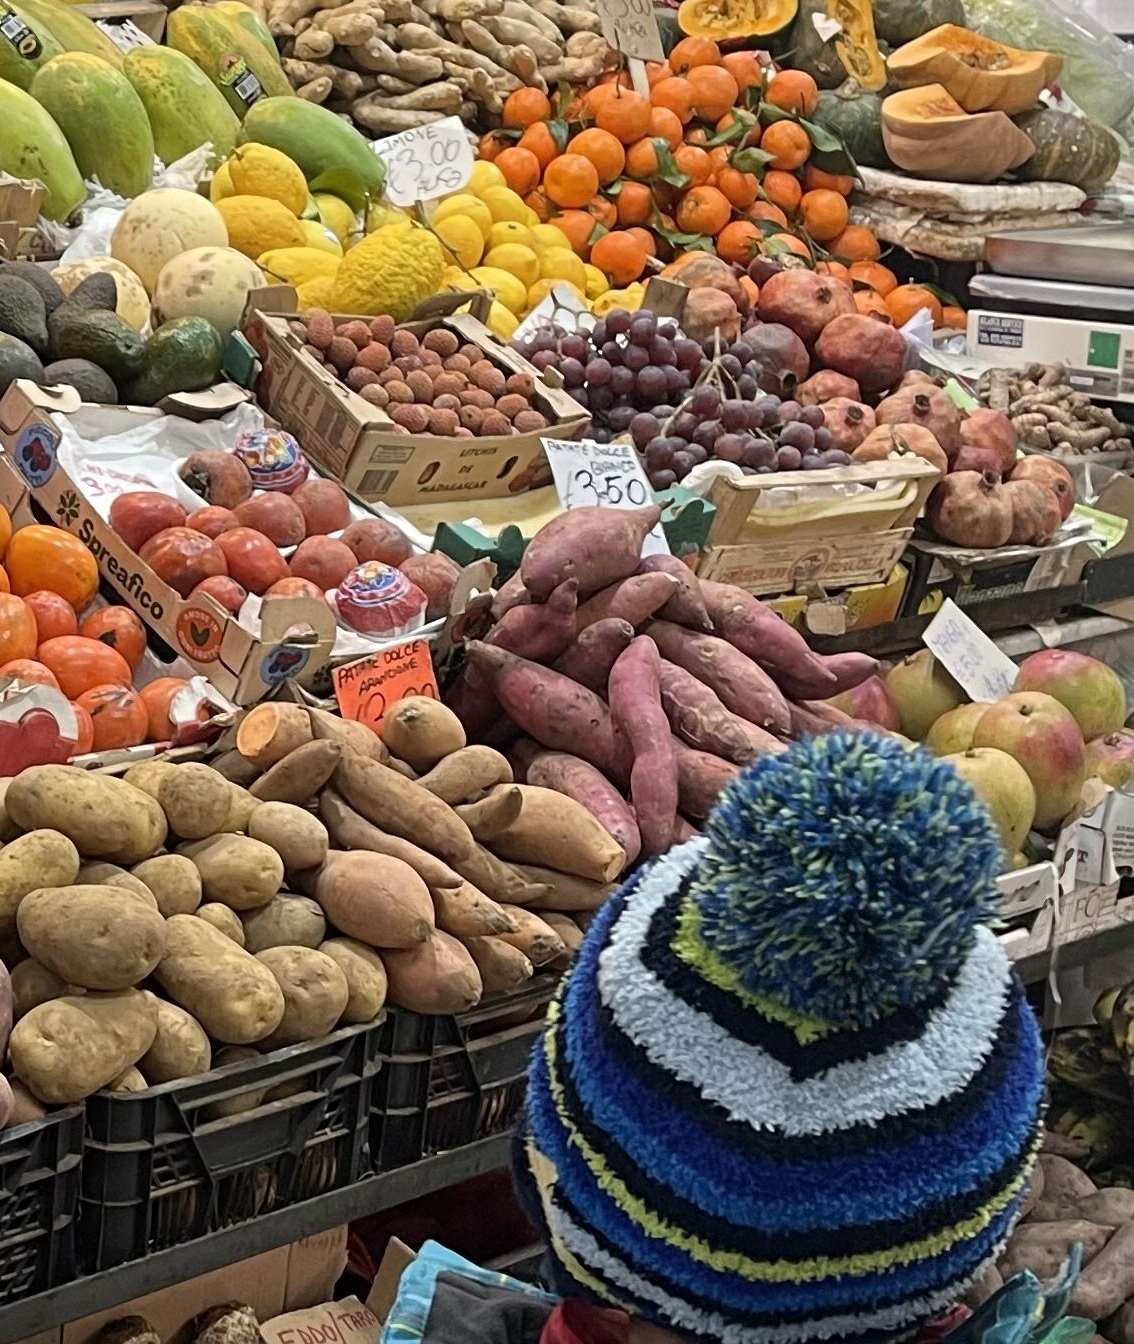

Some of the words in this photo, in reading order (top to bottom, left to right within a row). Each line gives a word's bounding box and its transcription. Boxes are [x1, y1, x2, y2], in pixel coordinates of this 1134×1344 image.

[593, 445, 631, 458] DOLCE
[417, 480, 489, 494] MADAGASCAR
[78, 518, 165, 621] Spreafico
[384, 643, 421, 665] DOLCE
